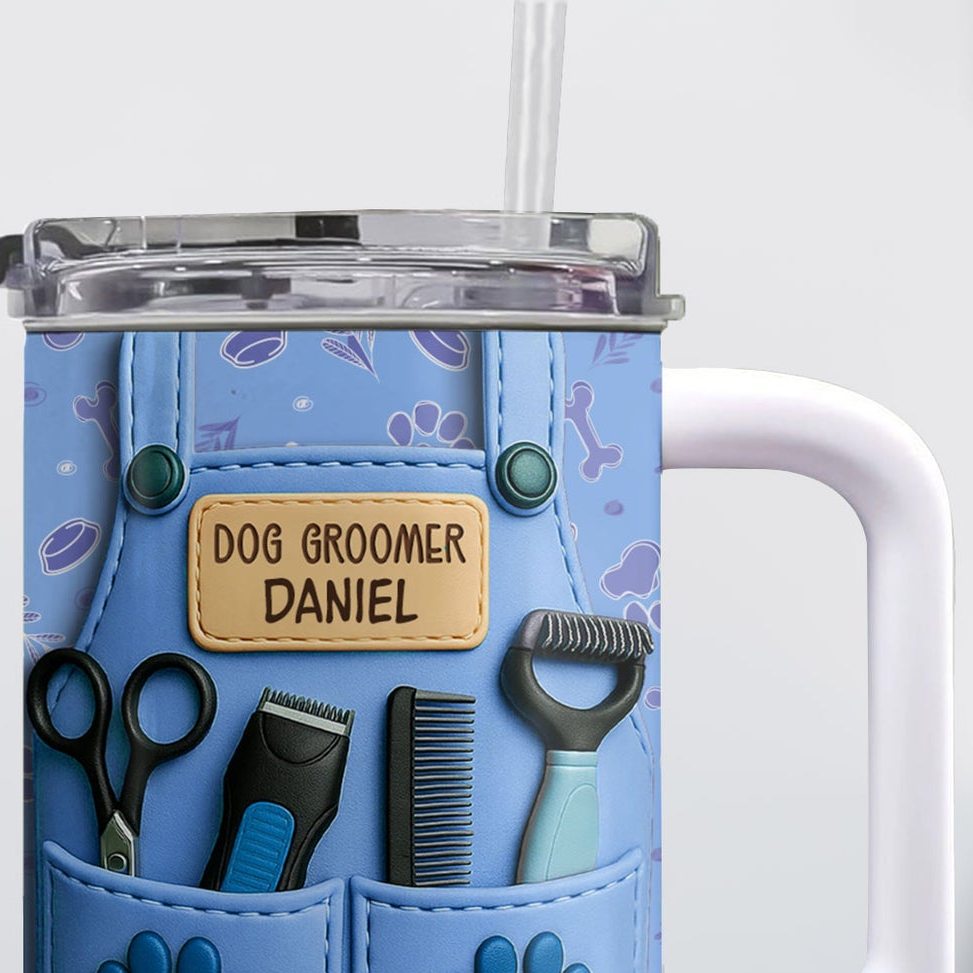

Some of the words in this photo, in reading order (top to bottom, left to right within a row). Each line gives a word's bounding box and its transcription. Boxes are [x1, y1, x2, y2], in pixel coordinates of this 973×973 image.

[213, 522, 284, 565] DOG
[300, 522, 467, 565] GROOMER
[263, 576, 419, 625] DANIEL
